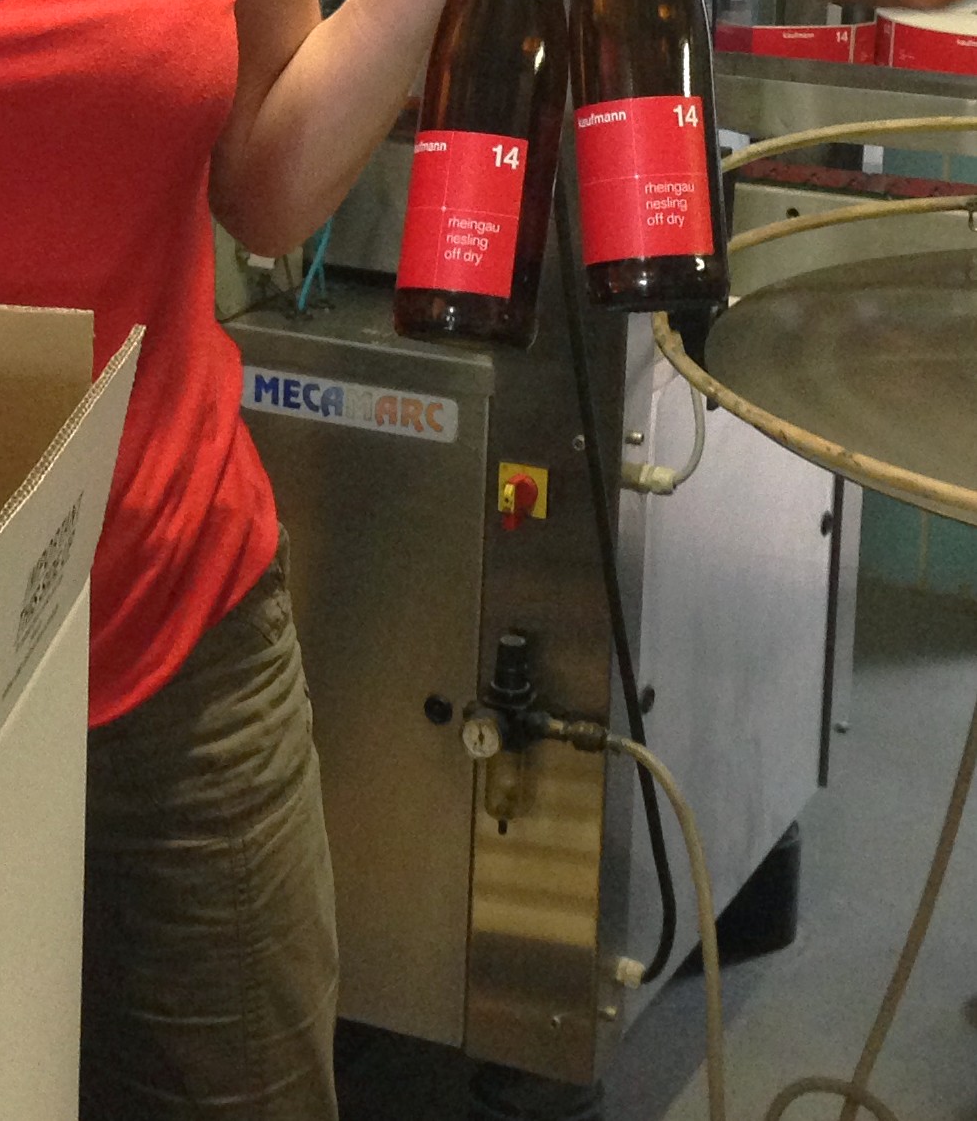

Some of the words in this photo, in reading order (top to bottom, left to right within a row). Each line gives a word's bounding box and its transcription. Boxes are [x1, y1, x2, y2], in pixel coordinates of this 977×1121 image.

[836, 31, 848, 42] 14
[673, 104, 698, 127] 14
[492, 144, 519, 170] 14
[644, 182, 695, 196] rheingau
[646, 197, 688, 212] riesling
[448, 217, 500, 235] rheingau
[647, 213, 664, 226] off
[666, 213, 685, 227] dry
[446, 233, 489, 251] riesling
[444, 247, 461, 260] off
[463, 248, 483, 266] dry
[254, 374, 444, 432] MECAMARC
